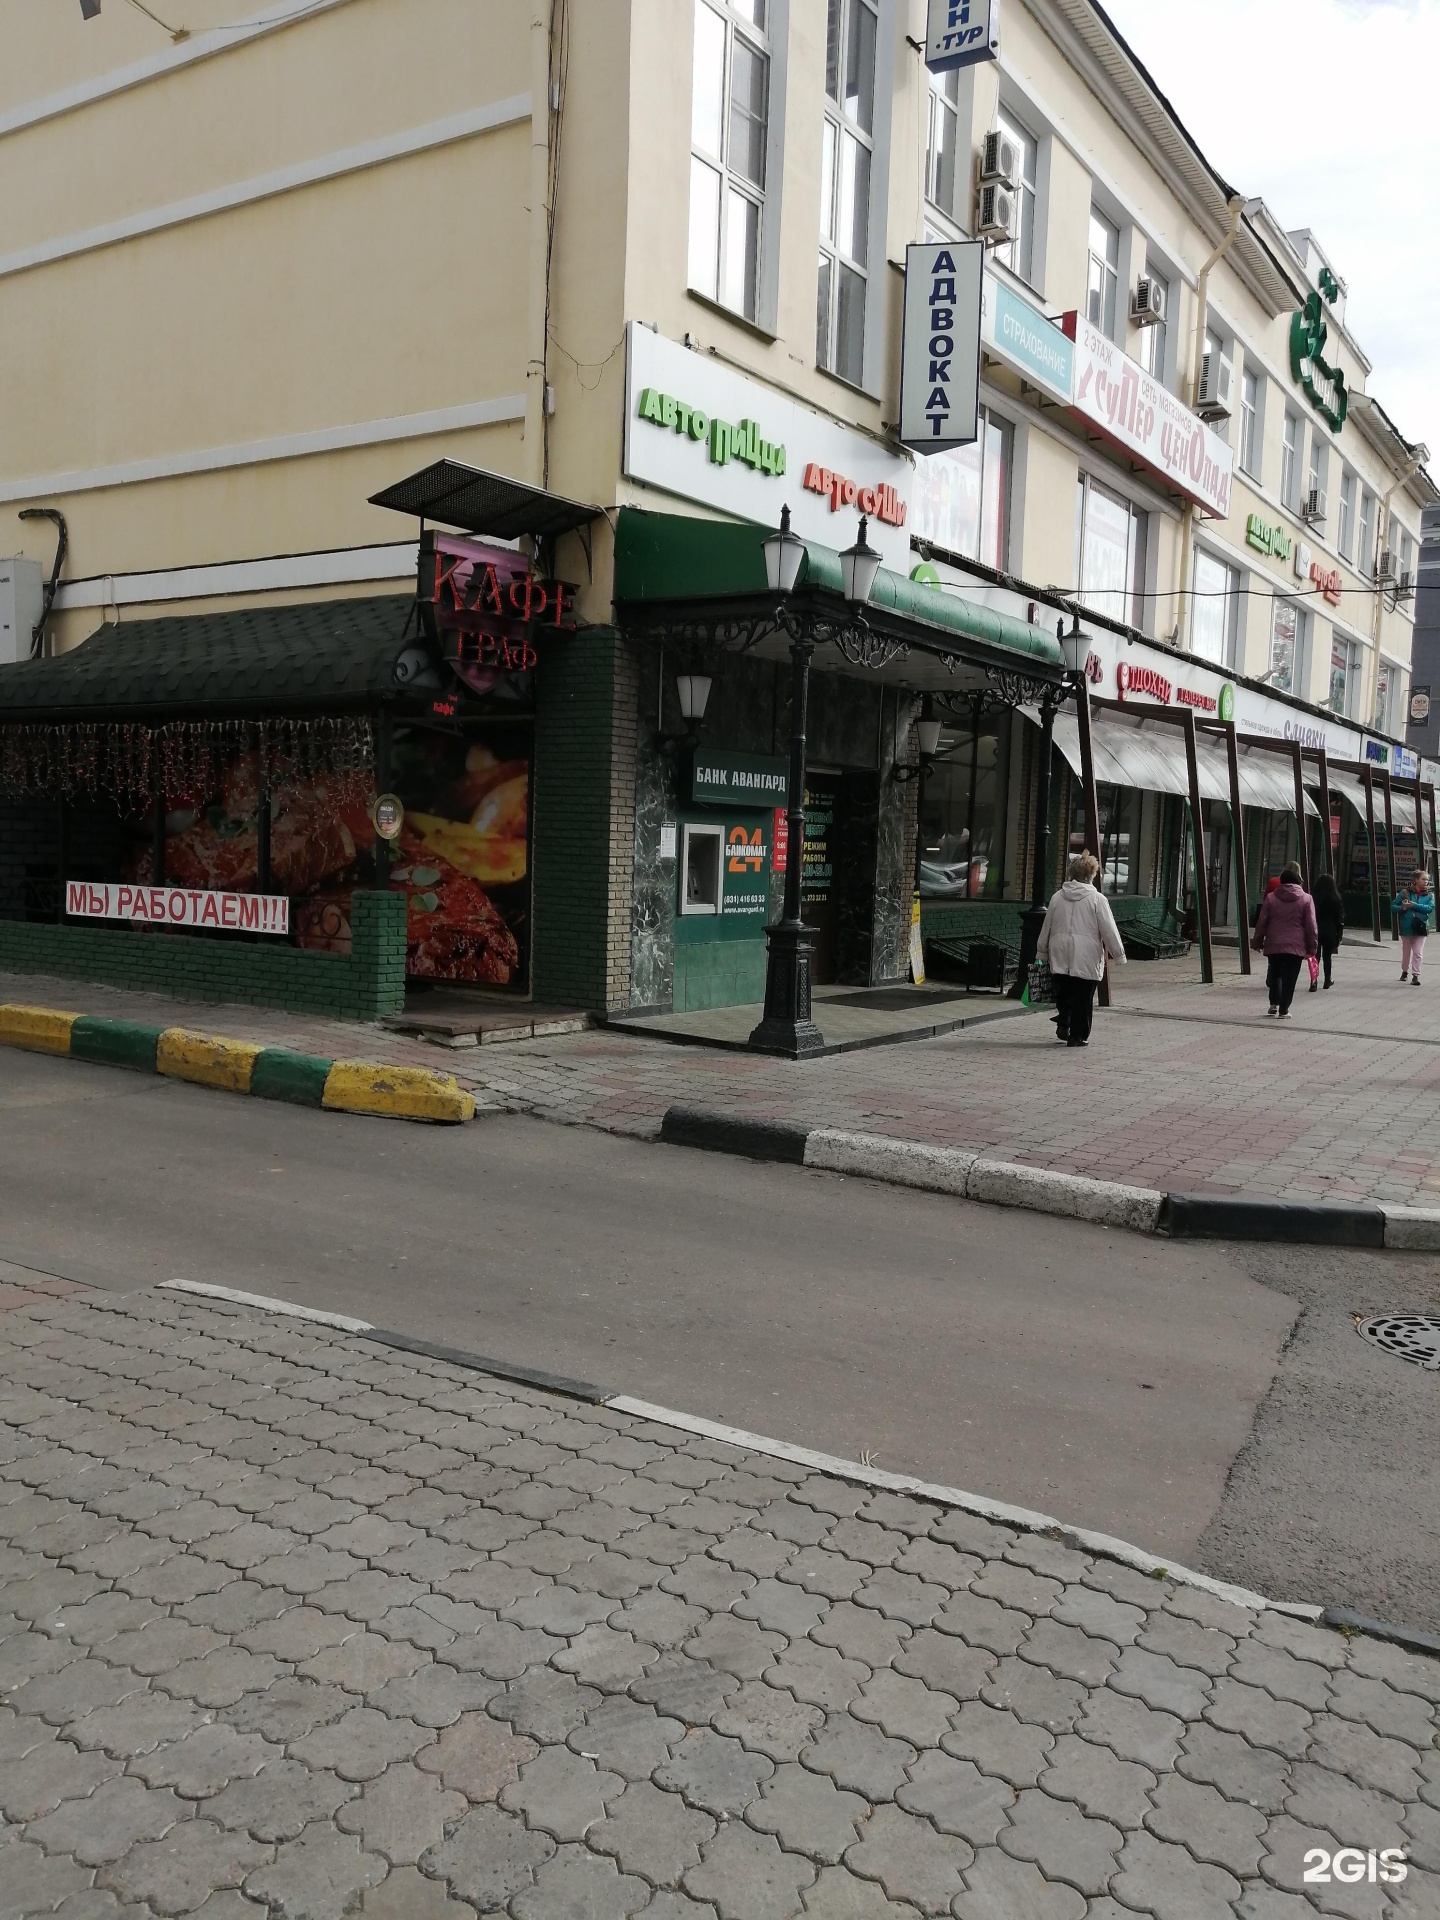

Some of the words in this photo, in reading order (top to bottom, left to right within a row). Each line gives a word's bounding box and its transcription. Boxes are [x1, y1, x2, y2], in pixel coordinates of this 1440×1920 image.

[925, 250, 957, 436] АДВОКАТ
[1003, 313, 1066, 378] СТРАХОВАНИЕ
[1084, 330, 1089, 347] 2
[1091, 336, 1113, 368] ЭТАЖ
[639, 388, 709, 442] АВТО
[1141, 379, 1157, 405] сеть
[1159, 394, 1192, 434] магазинов
[803, 462, 857, 513] АВТО
[430, 551, 581, 631] КАФЕ
[455, 628, 537, 672] ГРАФ
[696, 766, 727, 785] БАНК
[731, 770, 786, 792] АВАНГАРД
[725, 844, 767, 857] БАНКОМАТ
[729, 825, 763, 873] 24
[803, 841, 826, 851] РЕЖИМ
[803, 853, 826, 862] РАБОТЫ
[69, 883, 110, 915] МЫ
[117, 887, 288, 931] РАБОТАЕМ!!!
[724, 895, 739, 905] (831)
[740, 895, 750, 903] 416
[751, 895, 758, 903] 63
[724, 905, 765, 914] www.avangard.ru
